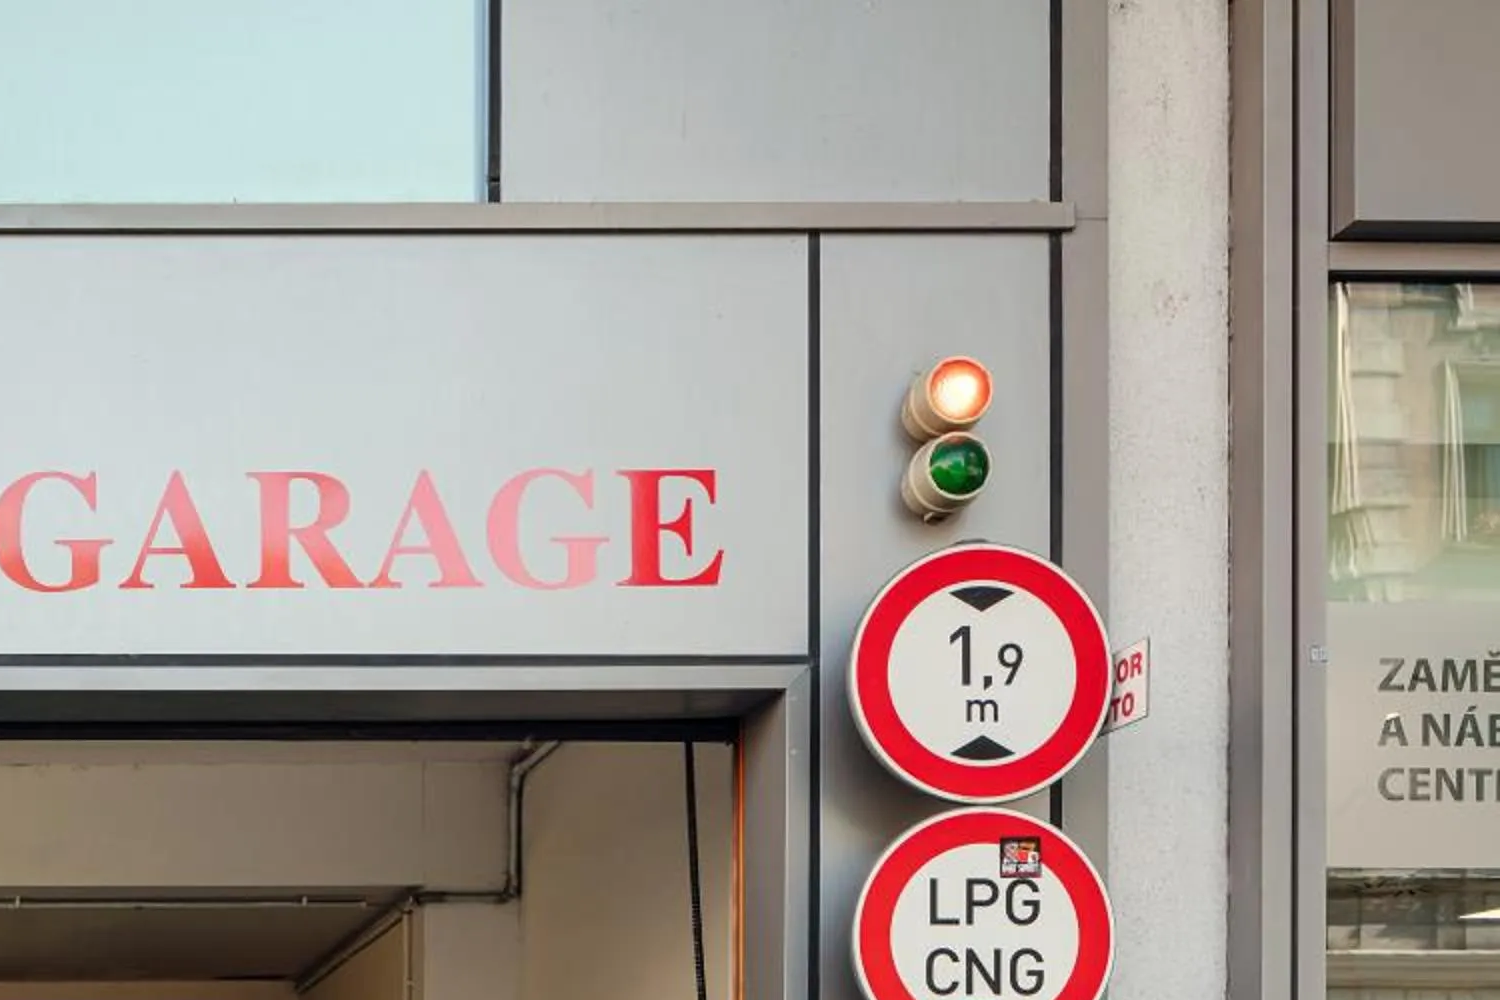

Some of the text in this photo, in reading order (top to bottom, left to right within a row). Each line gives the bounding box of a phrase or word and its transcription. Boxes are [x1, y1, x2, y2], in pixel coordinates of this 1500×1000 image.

[949, 625, 1024, 691] 1,9
[1114, 651, 1142, 685] OR
[965, 699, 999, 723] m
[1377, 712, 1408, 747] A
[1376, 767, 1500, 803] CENT
[929, 877, 1041, 926] LPG
[925, 947, 1045, 996] CNG
